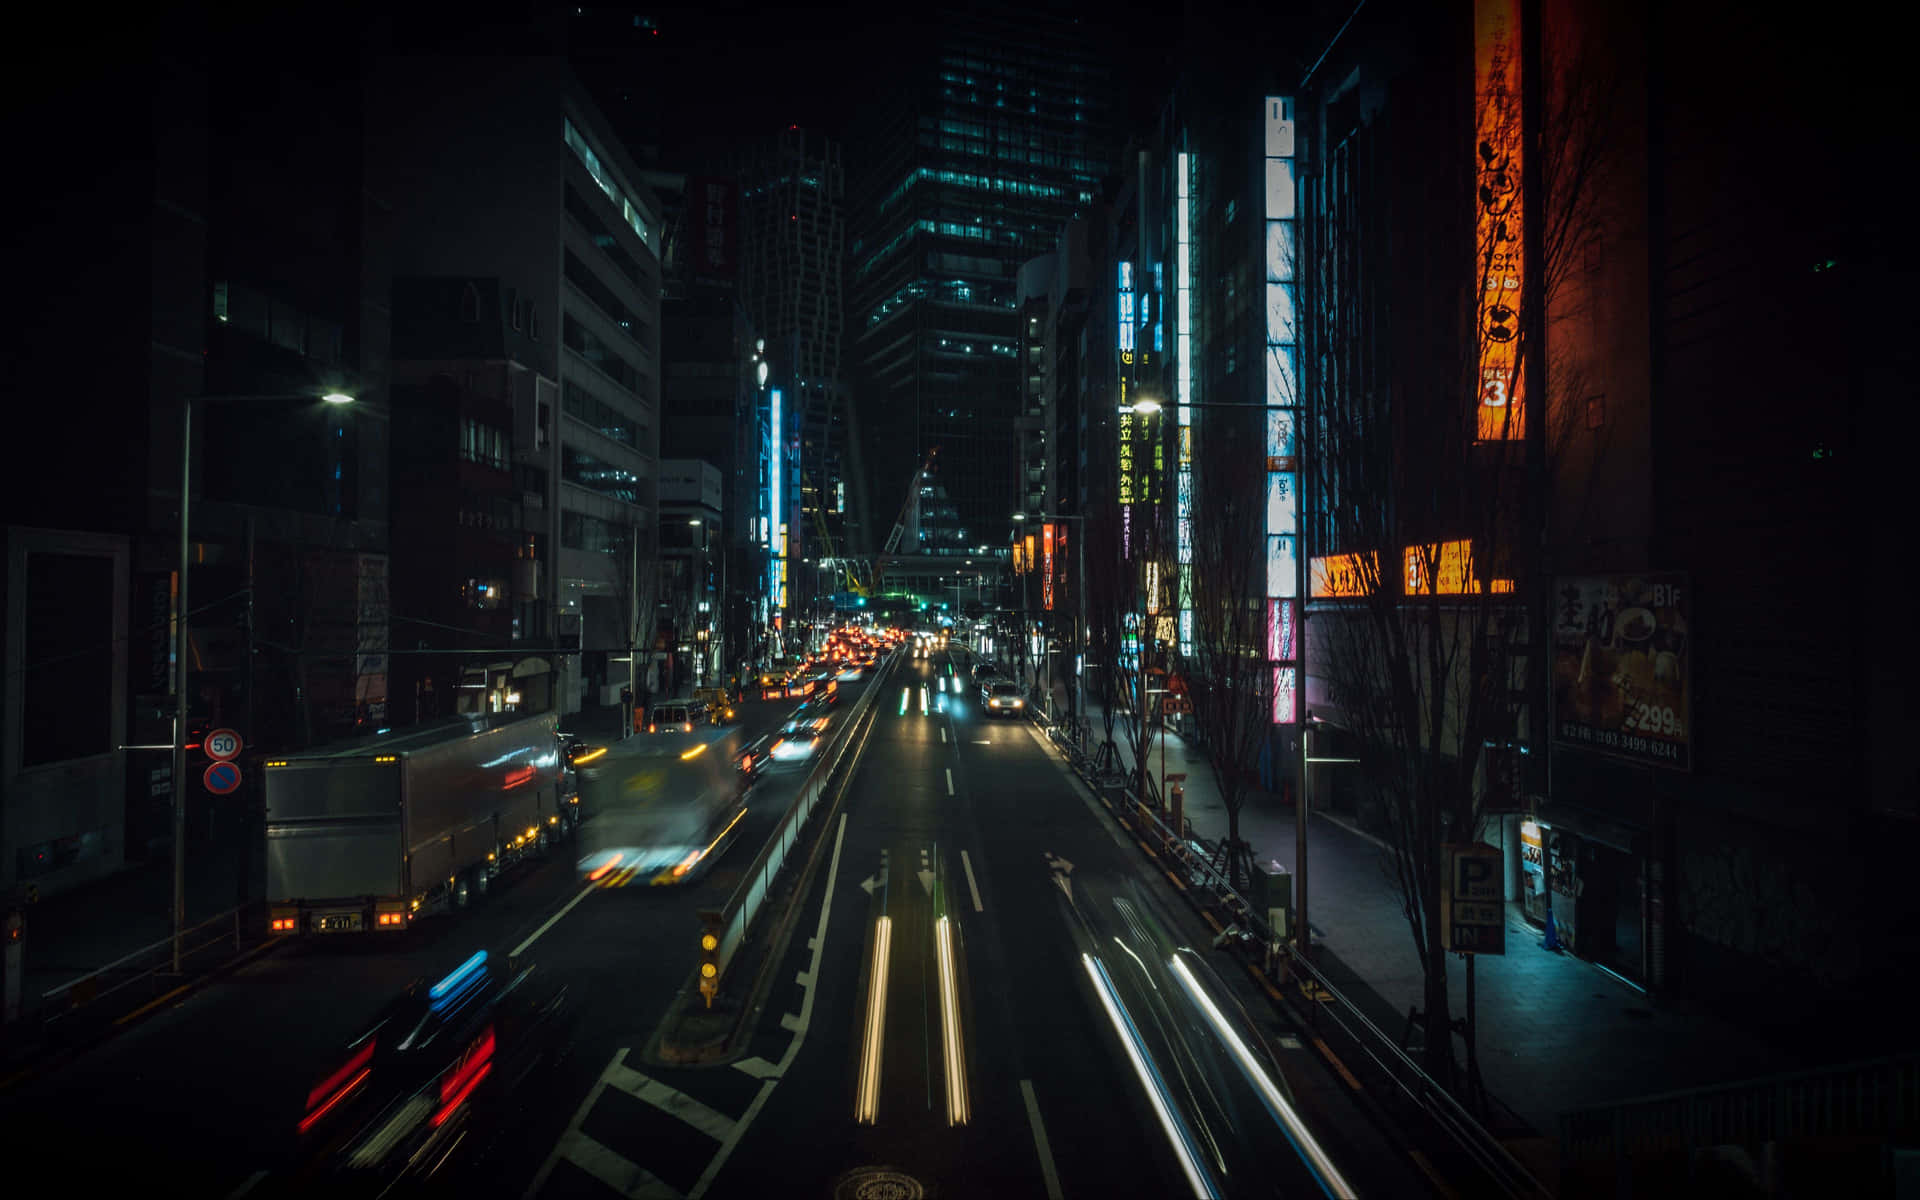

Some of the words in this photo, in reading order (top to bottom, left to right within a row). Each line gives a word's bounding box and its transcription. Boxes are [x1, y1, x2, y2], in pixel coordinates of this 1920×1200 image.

[213, 738, 235, 753] 50
[1460, 857, 1490, 895] P
[1455, 927, 1479, 945] IN
